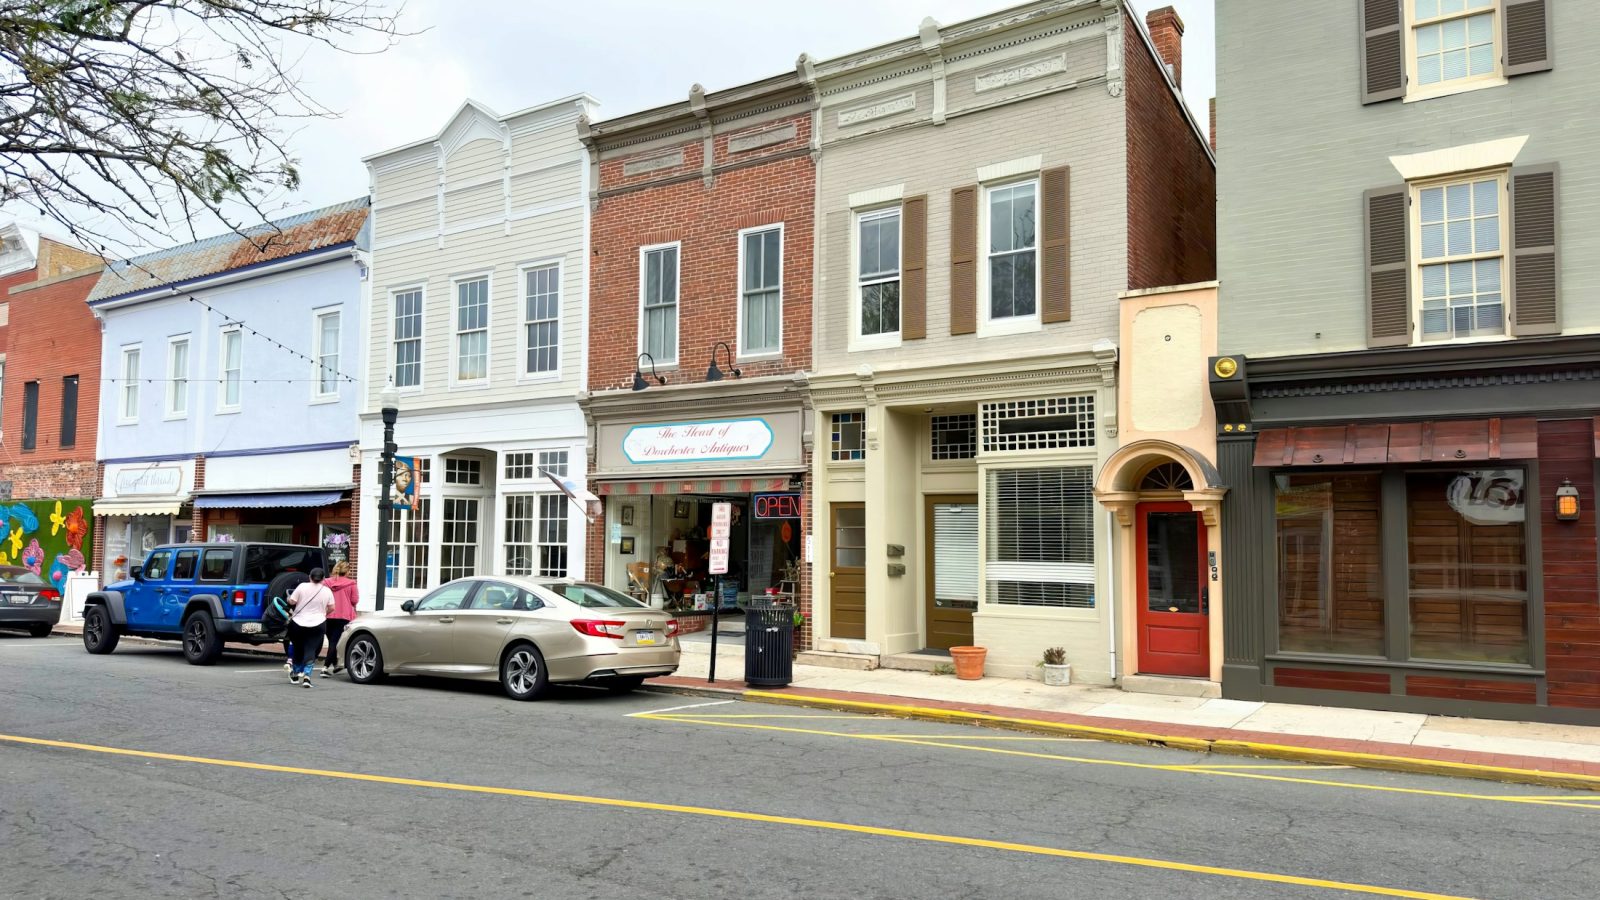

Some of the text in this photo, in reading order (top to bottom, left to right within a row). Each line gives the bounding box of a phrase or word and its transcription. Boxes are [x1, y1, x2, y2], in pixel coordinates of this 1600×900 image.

[657, 424, 731, 439] The Heart of
[642, 442, 750, 457] Dorchester Antiques
[756, 496, 801, 517] OPEN
